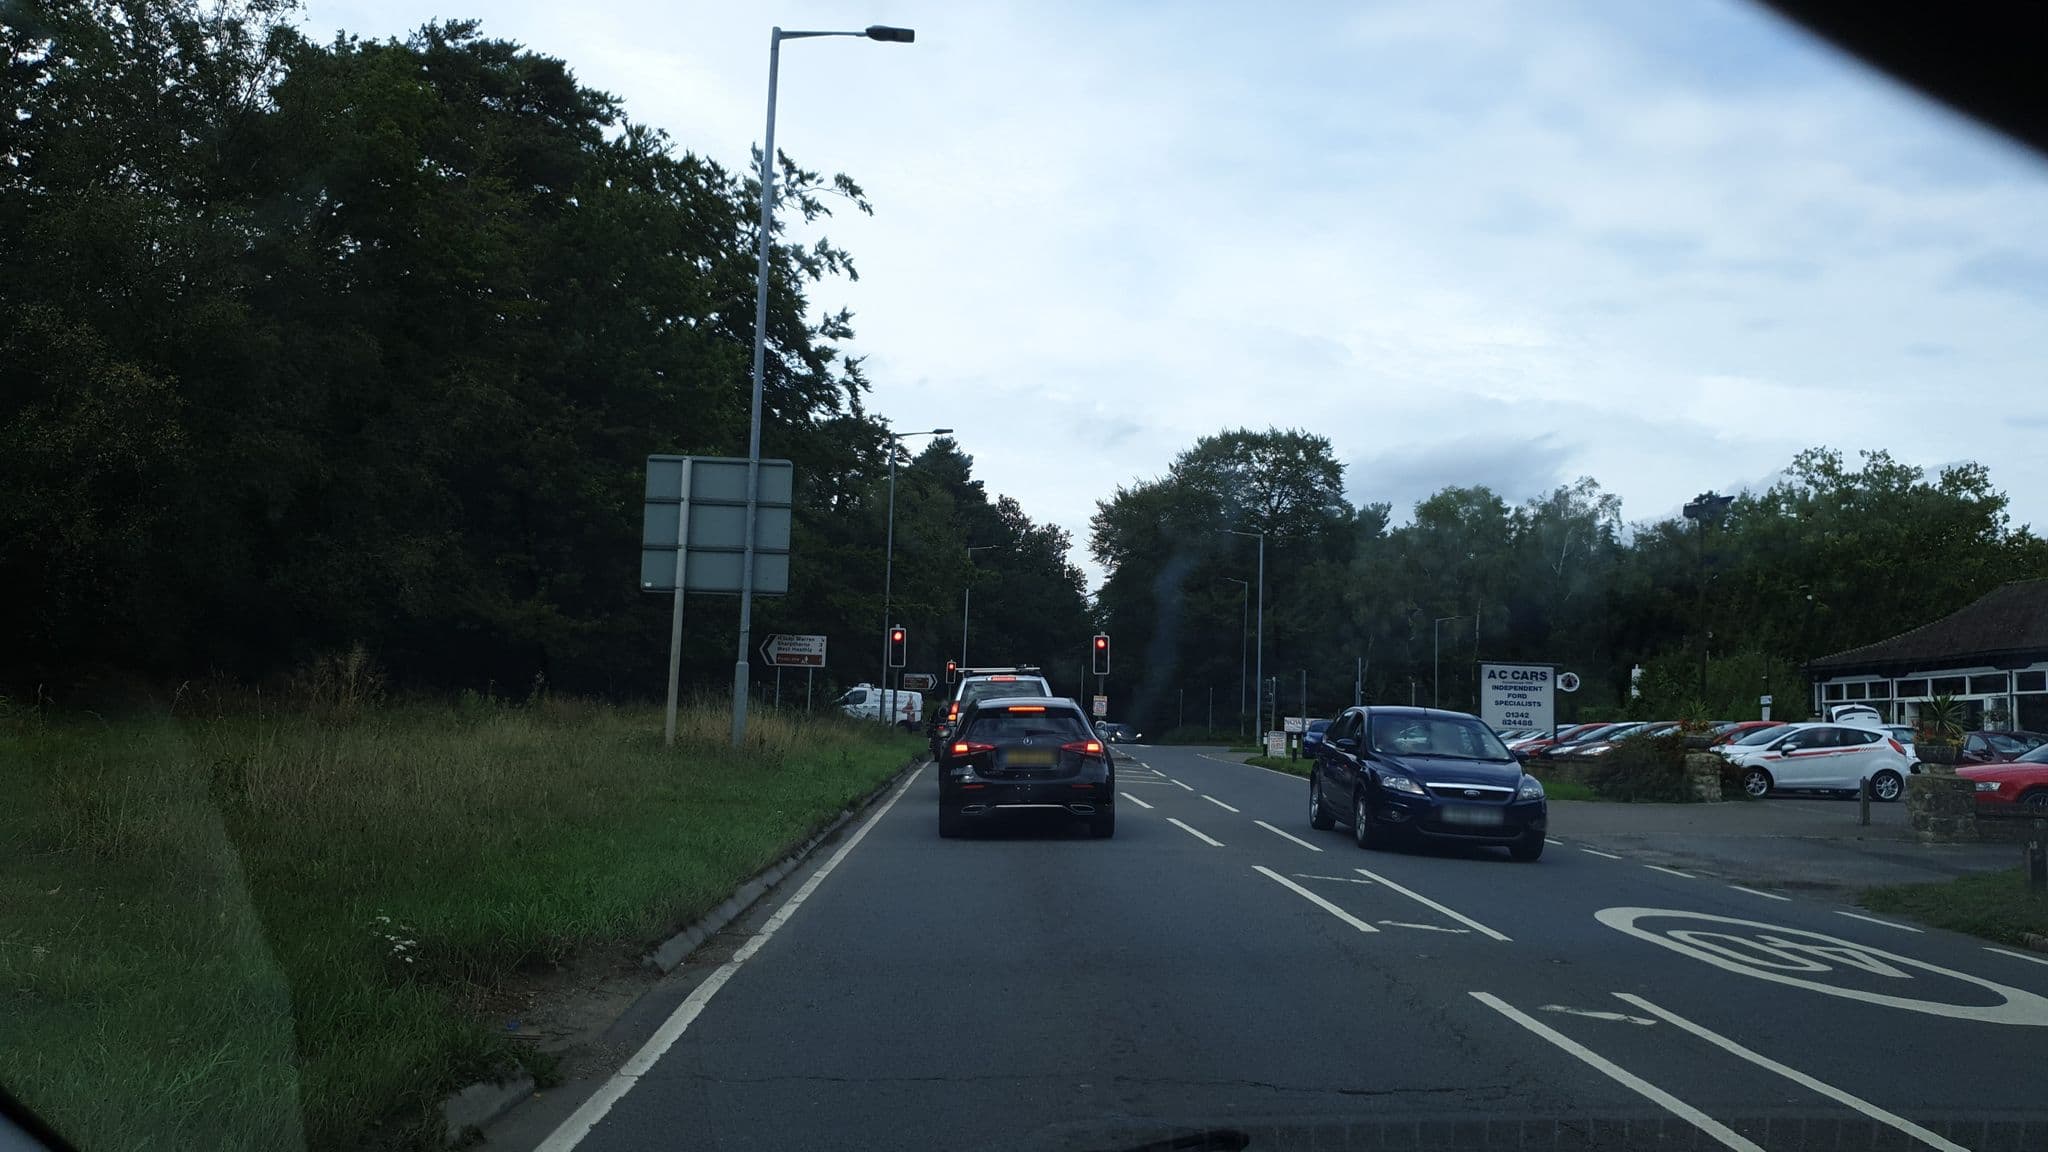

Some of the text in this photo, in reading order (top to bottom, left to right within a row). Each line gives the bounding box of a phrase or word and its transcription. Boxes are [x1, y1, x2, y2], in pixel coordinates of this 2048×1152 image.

[1511, 670, 1548, 681] CARS
[1491, 684, 1543, 692] INDEPENDENT
[1505, 711, 1530, 719] 01342
